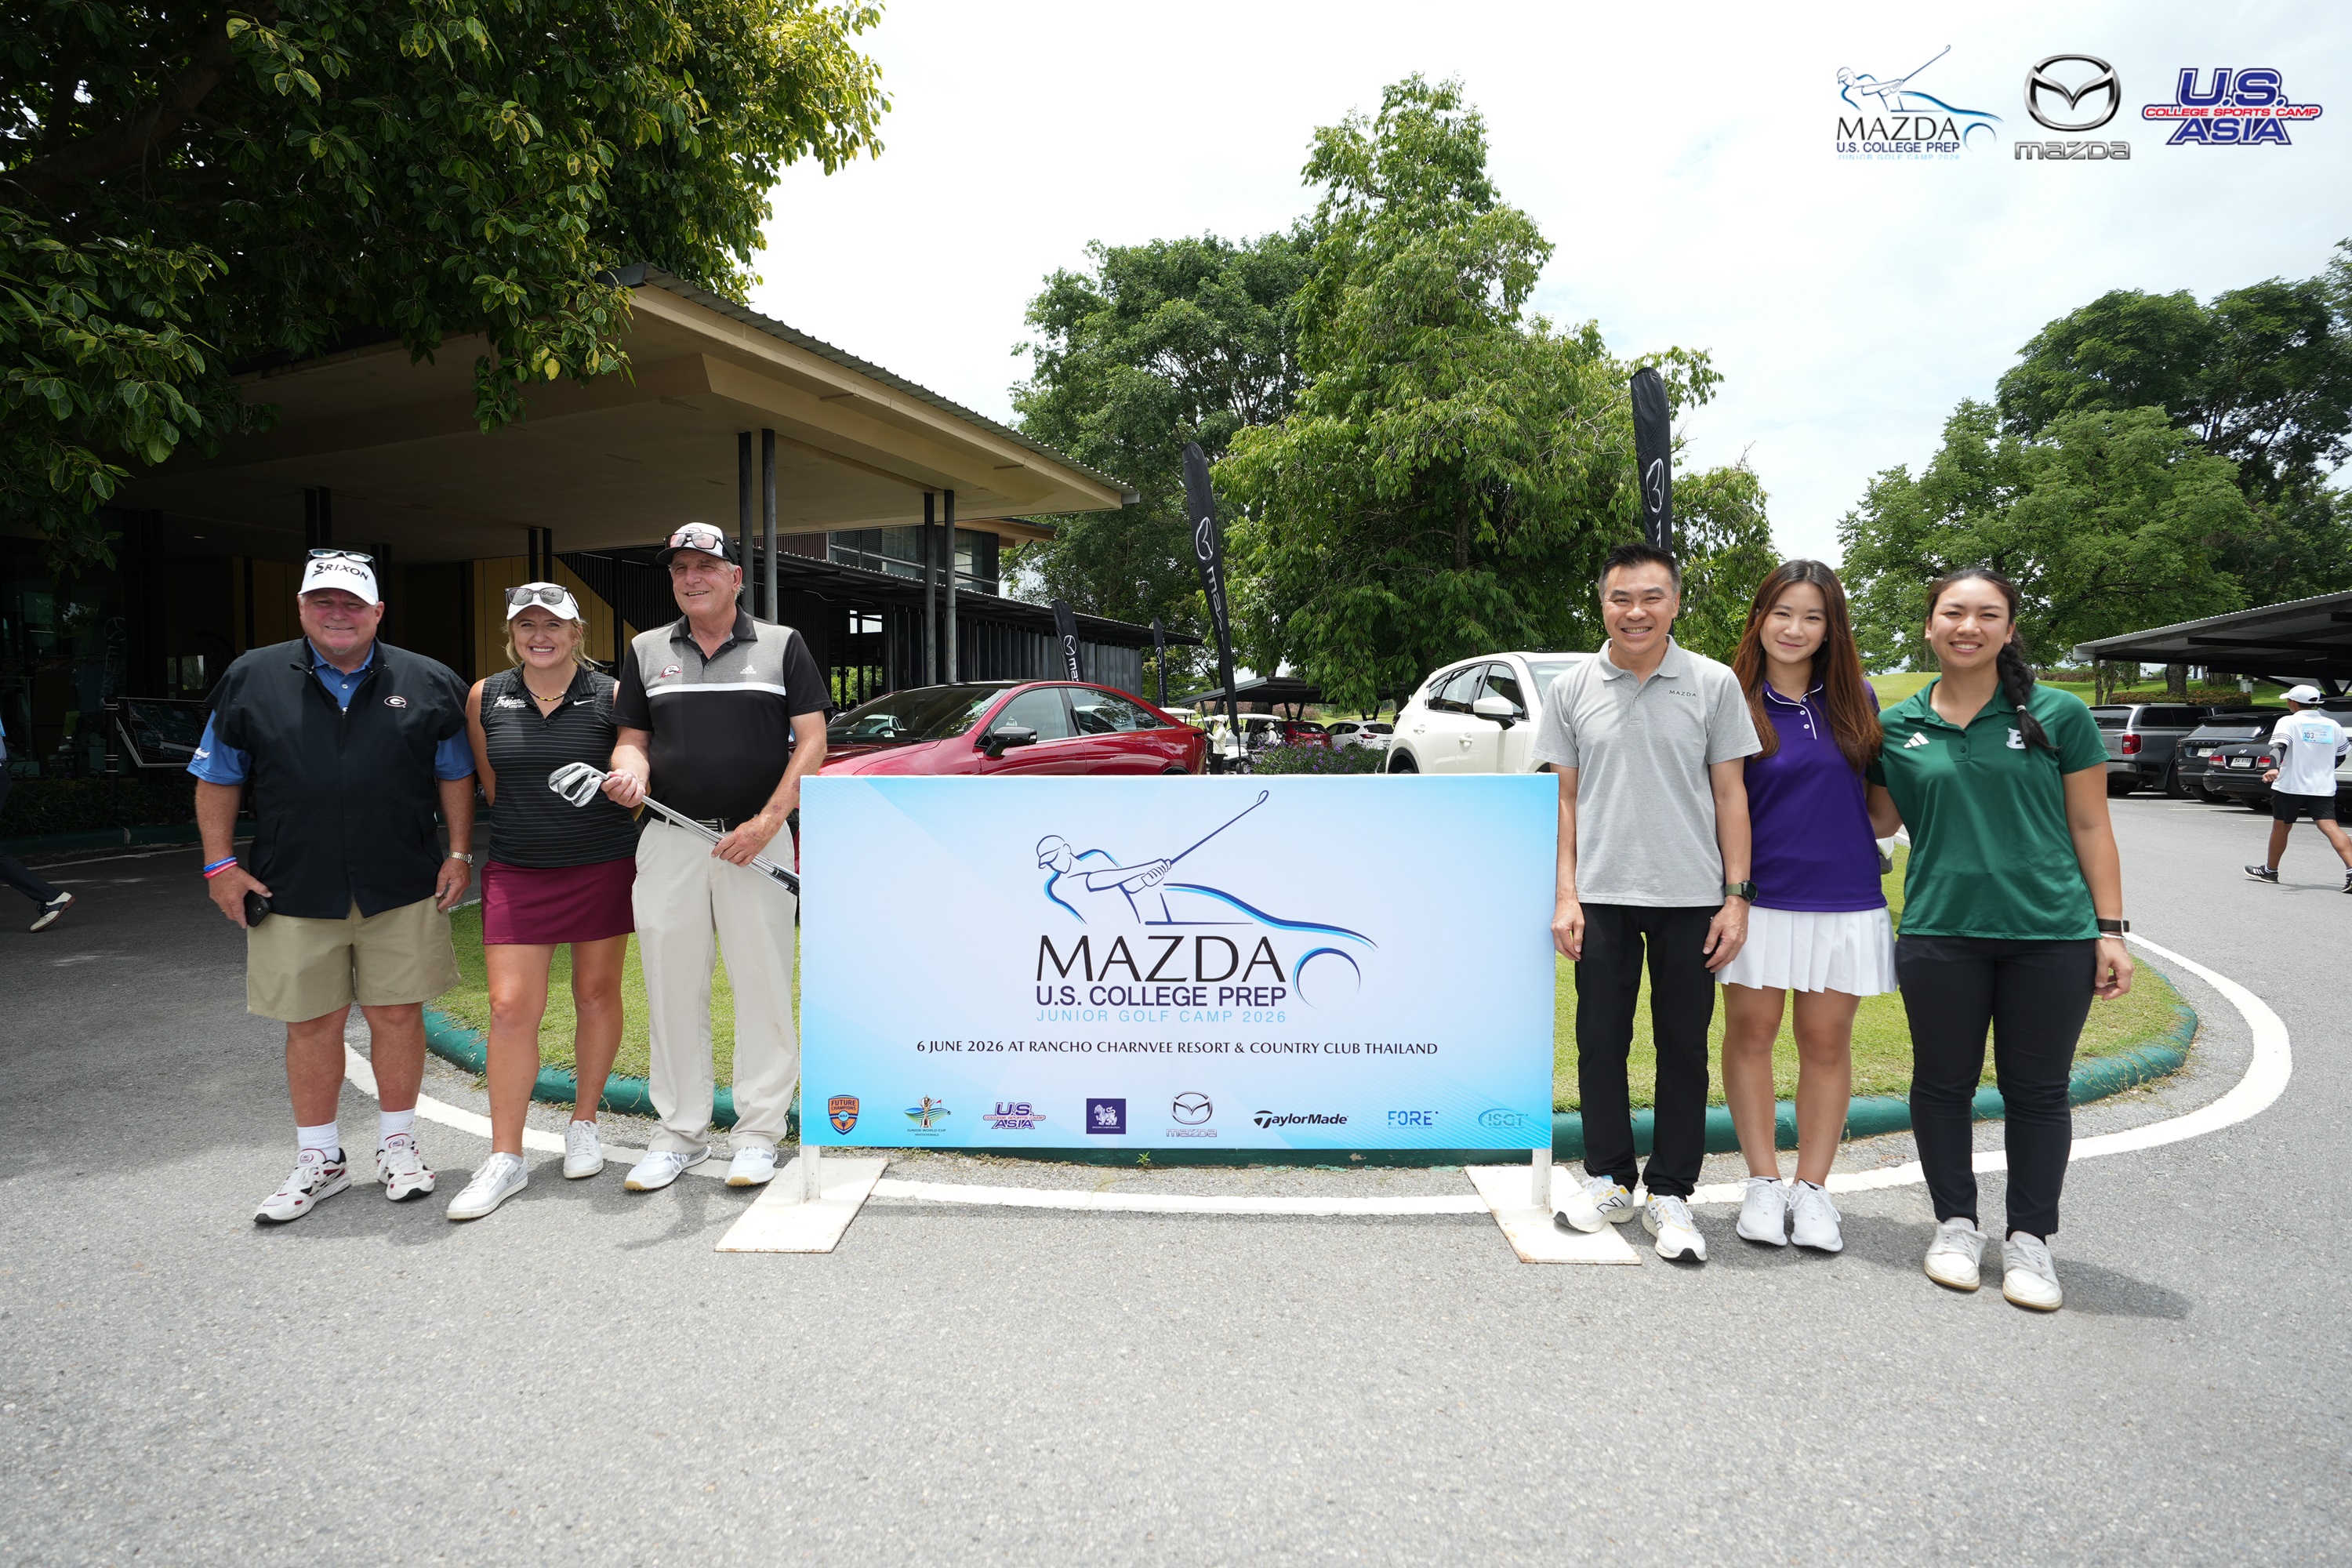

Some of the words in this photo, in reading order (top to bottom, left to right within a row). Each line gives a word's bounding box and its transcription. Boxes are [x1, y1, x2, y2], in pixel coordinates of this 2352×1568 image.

[312, 562, 369, 580] SRIXON
[1036, 935, 1287, 982] MAZDA
[1036, 985, 1082, 1006] U.S.
[1089, 985, 1208, 1007] COLLEGE
[1218, 986, 1287, 1007] PREP
[1036, 1010, 1108, 1022] JUNIOR
[1119, 1010, 1169, 1022] GOLF
[1179, 1010, 1232, 1022] CAMP
[1243, 1011, 1286, 1022] 2026
[916, 1040, 925, 1052] 6
[928, 1040, 963, 1054] JUNE
[967, 1040, 1004, 1052] 2026
[1007, 1041, 1025, 1052] AT
[1029, 1041, 1092, 1052] RANCHO
[1097, 1041, 1174, 1053] CHARNVEE
[1178, 1042, 1230, 1053] RESORT
[1234, 1042, 1245, 1053] &
[1250, 1042, 1319, 1054] COUNTRY
[1323, 1043, 1360, 1054] CLUB
[1364, 1043, 1438, 1054] THAILAND
[996, 1104, 1033, 1116] U.S.
[994, 1120, 1033, 1128] ASIA
[1254, 1110, 1348, 1129] TaylorMade
[1388, 1110, 1433, 1125] FORE
[1166, 1129, 1218, 1138] mazda
